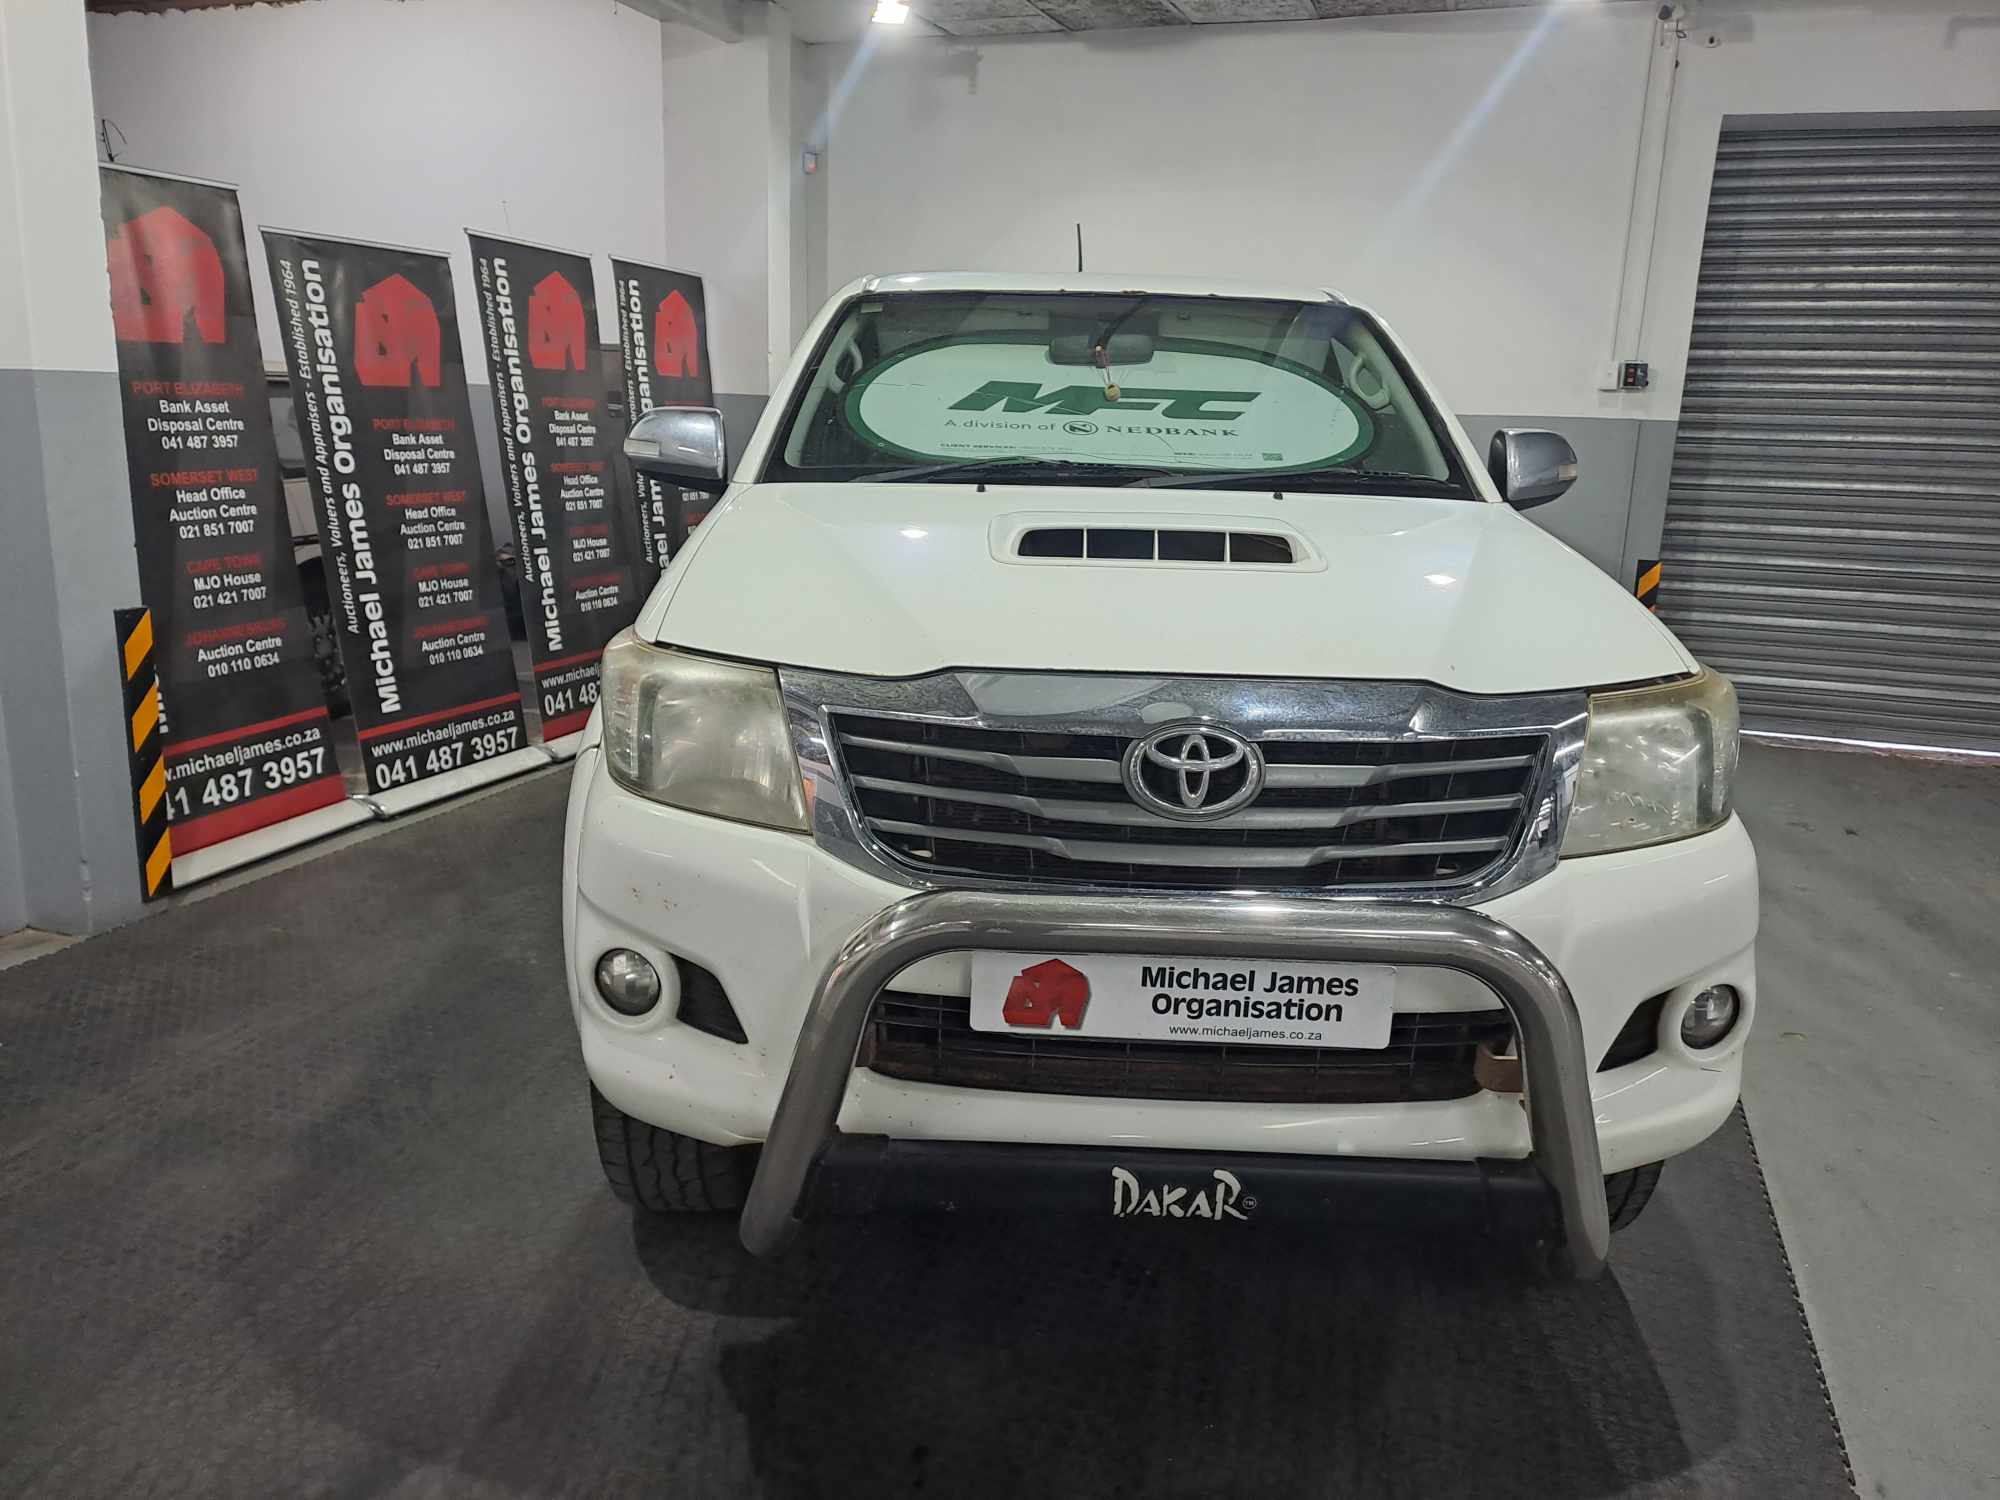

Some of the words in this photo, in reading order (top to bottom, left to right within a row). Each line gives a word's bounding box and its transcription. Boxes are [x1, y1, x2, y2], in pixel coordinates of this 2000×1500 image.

[280, 259, 297, 297] 1964
[479, 258, 491, 288] 1964
[286, 298, 312, 380] Established
[483, 290, 501, 362] Established
[493, 257, 532, 444] Organisation
[301, 259, 356, 475] Organisation
[160, 399, 192, 413] Bank
[195, 400, 230, 413] Asset
[496, 371, 512, 436] Appraisers
[947, 380, 1262, 421] MFC
[147, 418, 203, 434] Disposal
[206, 418, 244, 430] Centre
[305, 391, 329, 465] Appraisers
[963, 420, 1031, 431] division
[1037, 422, 1056, 431] of
[1106, 425, 1239, 437] NEDBANK
[161, 436, 183, 449] 041
[186, 435, 208, 449] 487
[212, 435, 238, 448] 3957
[391, 433, 417, 446] Bank
[418, 434, 444, 445] Asset
[503, 436, 516, 461] and
[384, 448, 425, 462] Disposal
[426, 448, 455, 460] Centre
[316, 466, 333, 495] and
[394, 463, 411, 475] 041
[412, 463, 428, 474] 487
[176, 489, 207, 503] Head
[210, 487, 245, 500] Office
[510, 463, 523, 507] Valuers
[521, 451, 547, 540] James
[560, 489, 583, 499] Auction
[169, 507, 217, 522] Auction
[220, 504, 257, 517] Centre
[324, 496, 343, 548] Valuers
[404, 507, 428, 520] Head
[430, 505, 456, 517] Office
[179, 525, 201, 539] 021
[203, 523, 225, 537] 851
[228, 520, 254, 534] 7007
[342, 482, 377, 585] James
[400, 523, 436, 535] Auction
[437, 520, 465, 532] Centre
[407, 536, 423, 550] 021
[425, 534, 442, 548] 851
[443, 533, 463, 546] 7007
[517, 511, 535, 583] Auctioneers,
[193, 576, 221, 591] MJO
[223, 573, 261, 587] House
[338, 551, 360, 634] Auctioneers,
[418, 580, 439, 593] MJO
[440, 578, 469, 590] House
[193, 595, 214, 609] 021
[217, 591, 238, 605] 421
[241, 586, 267, 601] 7007
[418, 596, 434, 608] 021
[435, 593, 451, 605] 421
[453, 590, 473, 603] 7007
[533, 547, 564, 652] Michael
[575, 591, 598, 601] Auction
[198, 644, 244, 662] Auction
[246, 636, 282, 652] Centre
[358, 592, 402, 714] Michael
[421, 638, 456, 652] Auction
[456, 631, 486, 645] Centre
[208, 662, 229, 678] 010
[230, 658, 251, 672] 110
[254, 652, 280, 668] 0634
[429, 653, 445, 665] 010
[446, 649, 462, 661] 110
[544, 688, 573, 716] 041
[371, 709, 515, 758] www.michaeljames.co.za
[375, 755, 418, 789] 041
[426, 742, 464, 773] 487
[470, 726, 519, 761] 3957
[202, 768, 253, 807] 487
[262, 746, 325, 789] 3957
[1141, 967, 1256, 993] Michael
[1263, 972, 1359, 997] James
[1151, 994, 1343, 1023] Organisation
[1169, 1025, 1322, 1042] www.michaeljames.co.za
